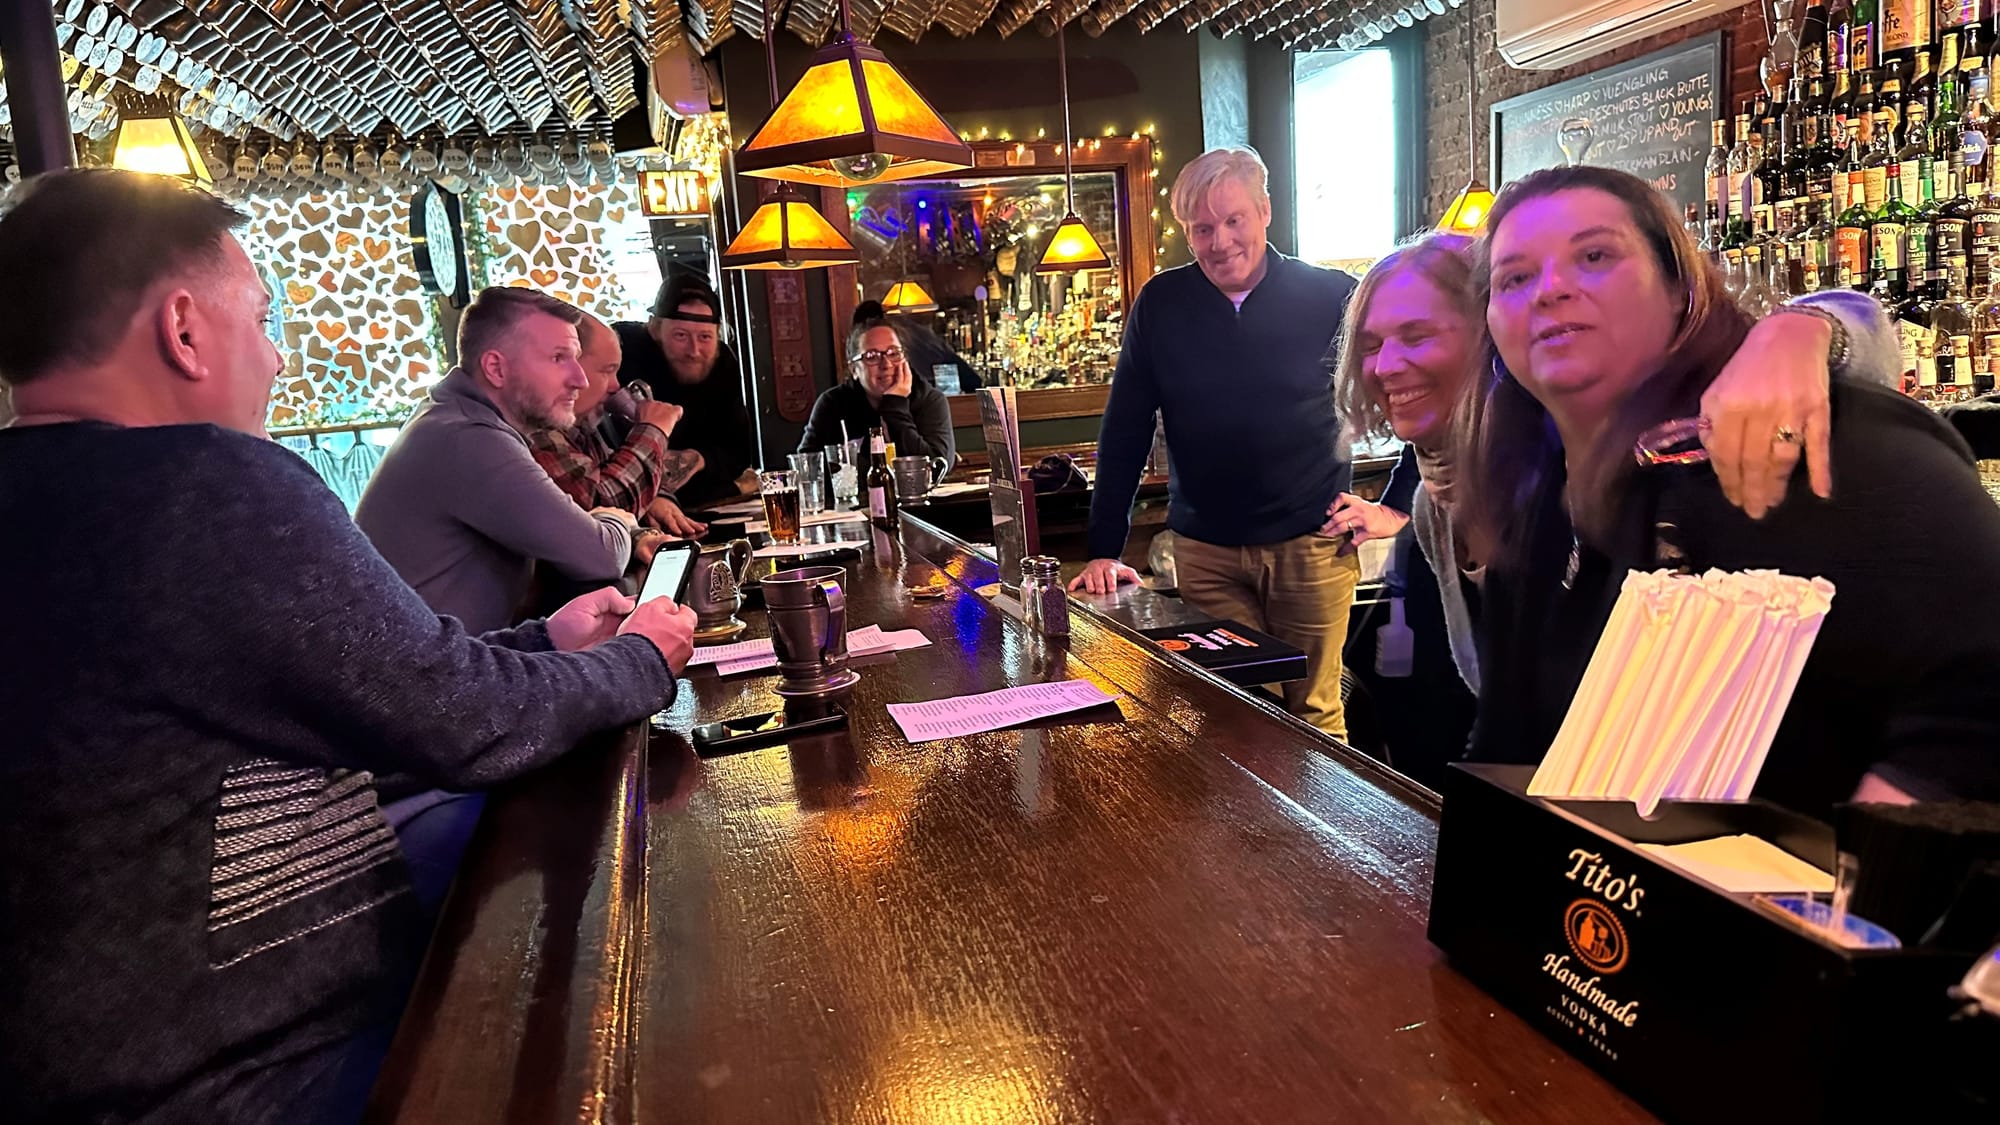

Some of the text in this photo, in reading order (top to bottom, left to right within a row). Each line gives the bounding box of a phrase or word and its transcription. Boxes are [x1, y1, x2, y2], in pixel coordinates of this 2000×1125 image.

[1602, 68, 1669, 101] YUENGLING
[1642, 86, 1675, 107] BLACK
[1677, 73, 1709, 94] BUTTE
[649, 171, 699, 213] EXIT
[1565, 848, 1645, 911] Tito's
[1542, 953, 1639, 1028] Handmade
[1561, 994, 1607, 1036] VODKA
